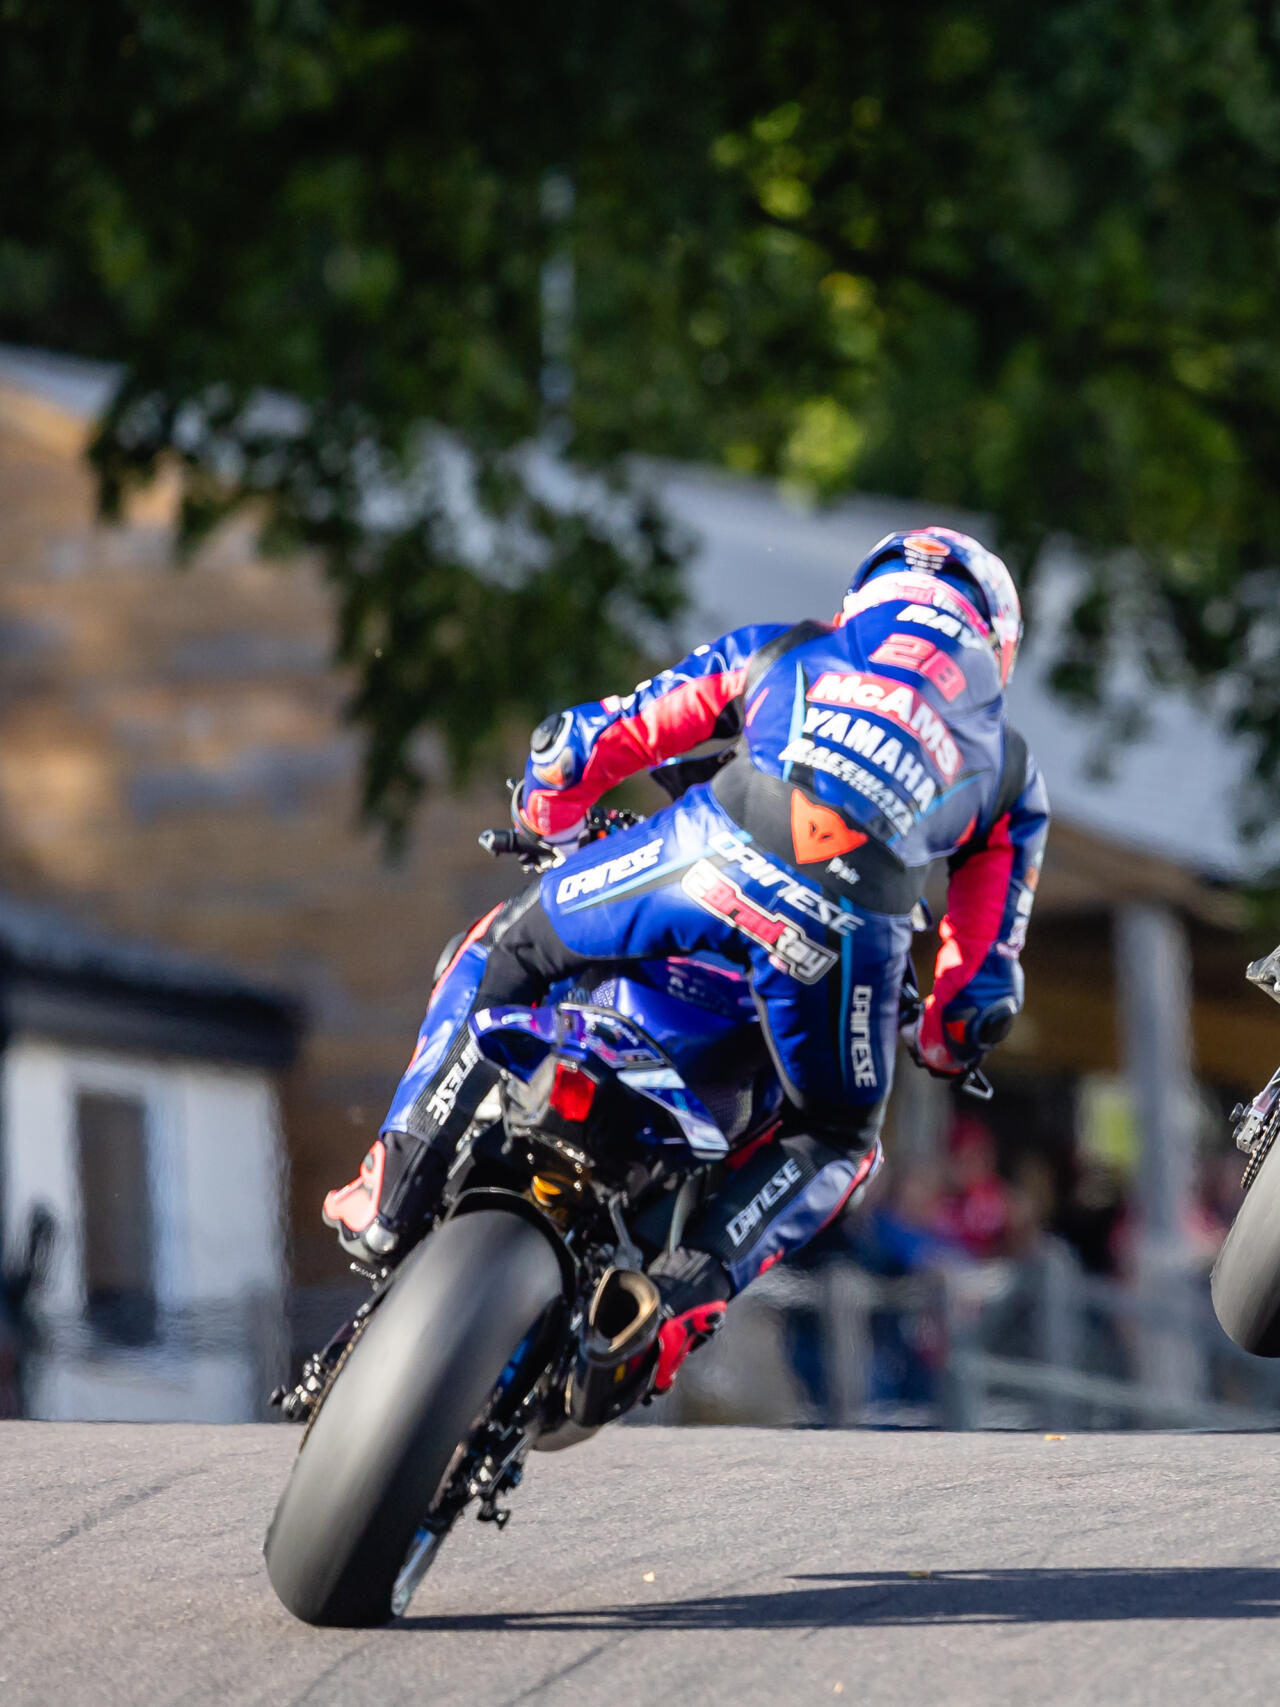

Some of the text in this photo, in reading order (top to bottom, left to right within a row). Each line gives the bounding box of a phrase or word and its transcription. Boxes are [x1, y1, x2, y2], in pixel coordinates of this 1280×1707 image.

[801, 706, 938, 814] YAMAHA
[555, 837, 665, 905] DAINESE
[708, 830, 866, 937] DAINESE
[850, 984, 878, 1089] DAINESE
[726, 1157, 803, 1248] DAINESE
